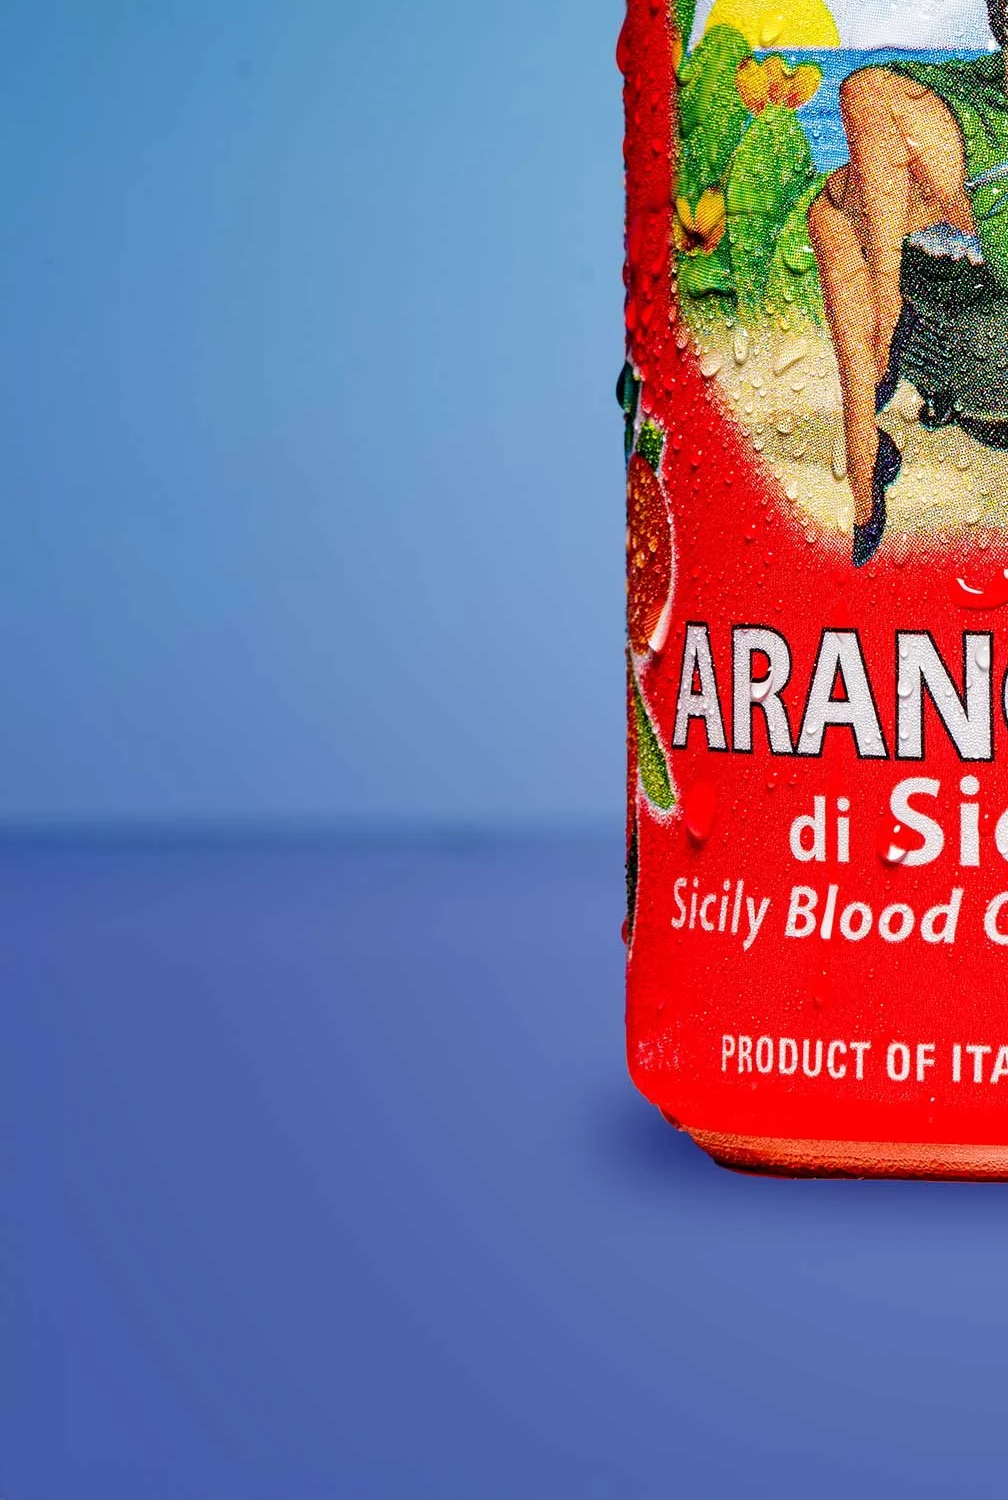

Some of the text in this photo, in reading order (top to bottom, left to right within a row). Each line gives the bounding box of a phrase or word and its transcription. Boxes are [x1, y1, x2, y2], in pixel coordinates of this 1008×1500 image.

[788, 796, 851, 863] di
[670, 877, 770, 952] Sicily
[784, 885, 962, 944] Blood
[720, 1034, 873, 1080] PRODUCT
[886, 1038, 936, 1084] OF
